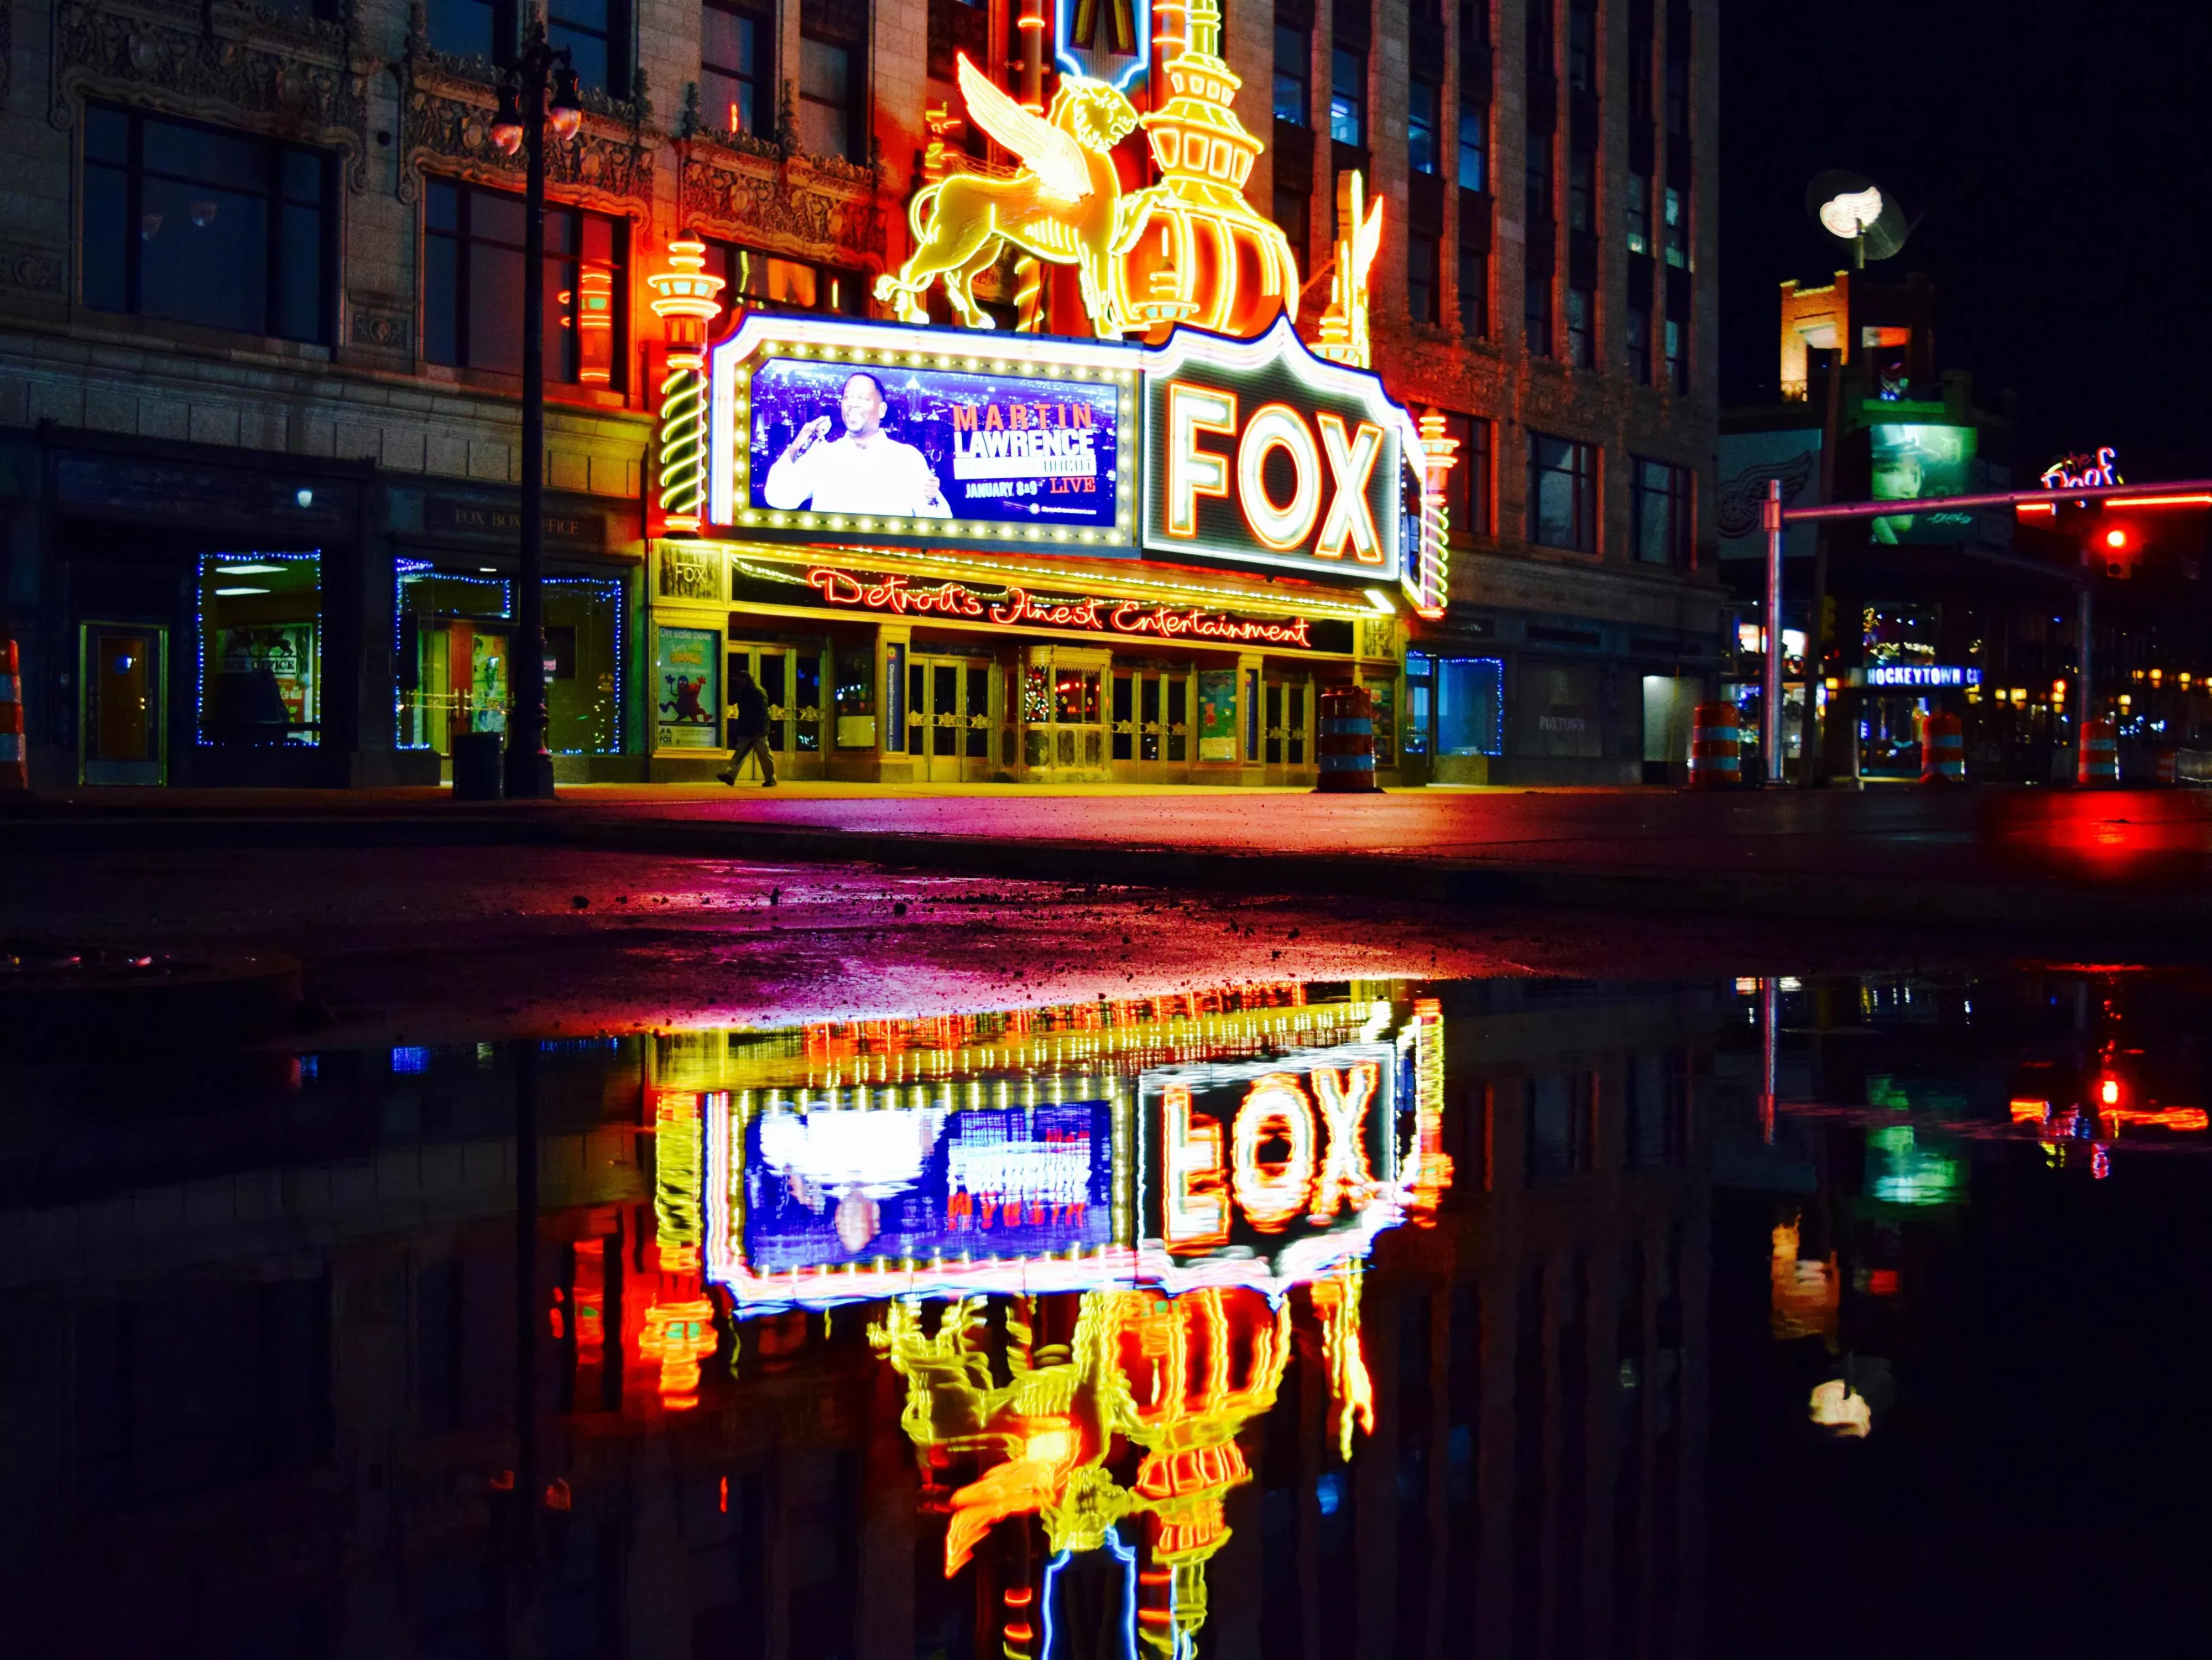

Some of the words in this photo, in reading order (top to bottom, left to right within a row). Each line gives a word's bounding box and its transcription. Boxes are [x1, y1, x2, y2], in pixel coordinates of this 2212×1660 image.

[953, 403, 1092, 431] MARTIN
[954, 429, 1095, 458] LAWRENCE
[1044, 459, 1092, 472] UNCUT
[2062, 450, 2092, 471] the
[1166, 380, 1385, 565] FOX
[966, 482, 1013, 498] JANUARY
[1050, 476, 1096, 493] LIVE
[455, 508, 485, 525] FOX
[492, 511, 522, 529] BOX
[542, 518, 580, 535] FICE
[675, 562, 707, 584] FOX
[806, 567, 983, 616] Detroit's
[990, 586, 1103, 629] Finest
[1110, 600, 1312, 648] Entertainment
[660, 628, 672, 638] On
[674, 629, 692, 639] sale
[1866, 667, 1961, 685] HOCKEYTOWN
